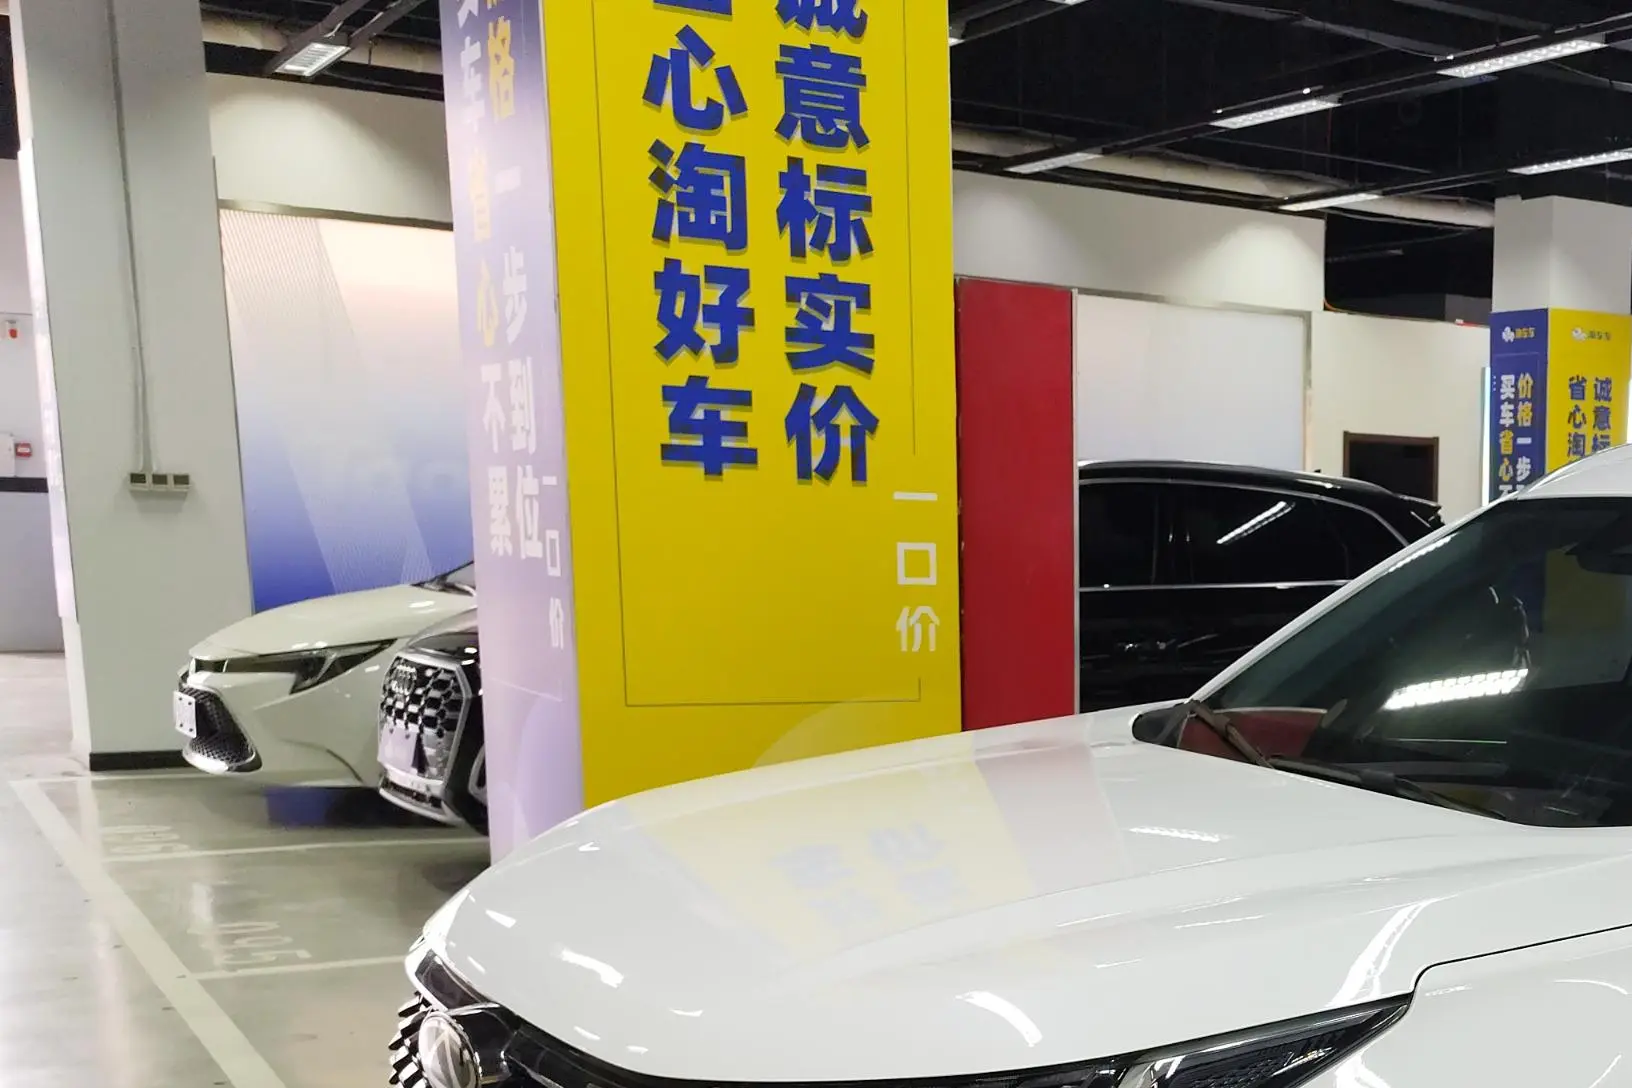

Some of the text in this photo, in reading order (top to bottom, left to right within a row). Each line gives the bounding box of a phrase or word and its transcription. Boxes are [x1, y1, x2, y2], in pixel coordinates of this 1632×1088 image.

[486, 0, 544, 560] 格一步到位
[642, 0, 758, 478] 心淘好车
[892, 491, 941, 654] 一口价
[1516, 373, 1533, 491] 价格一步
